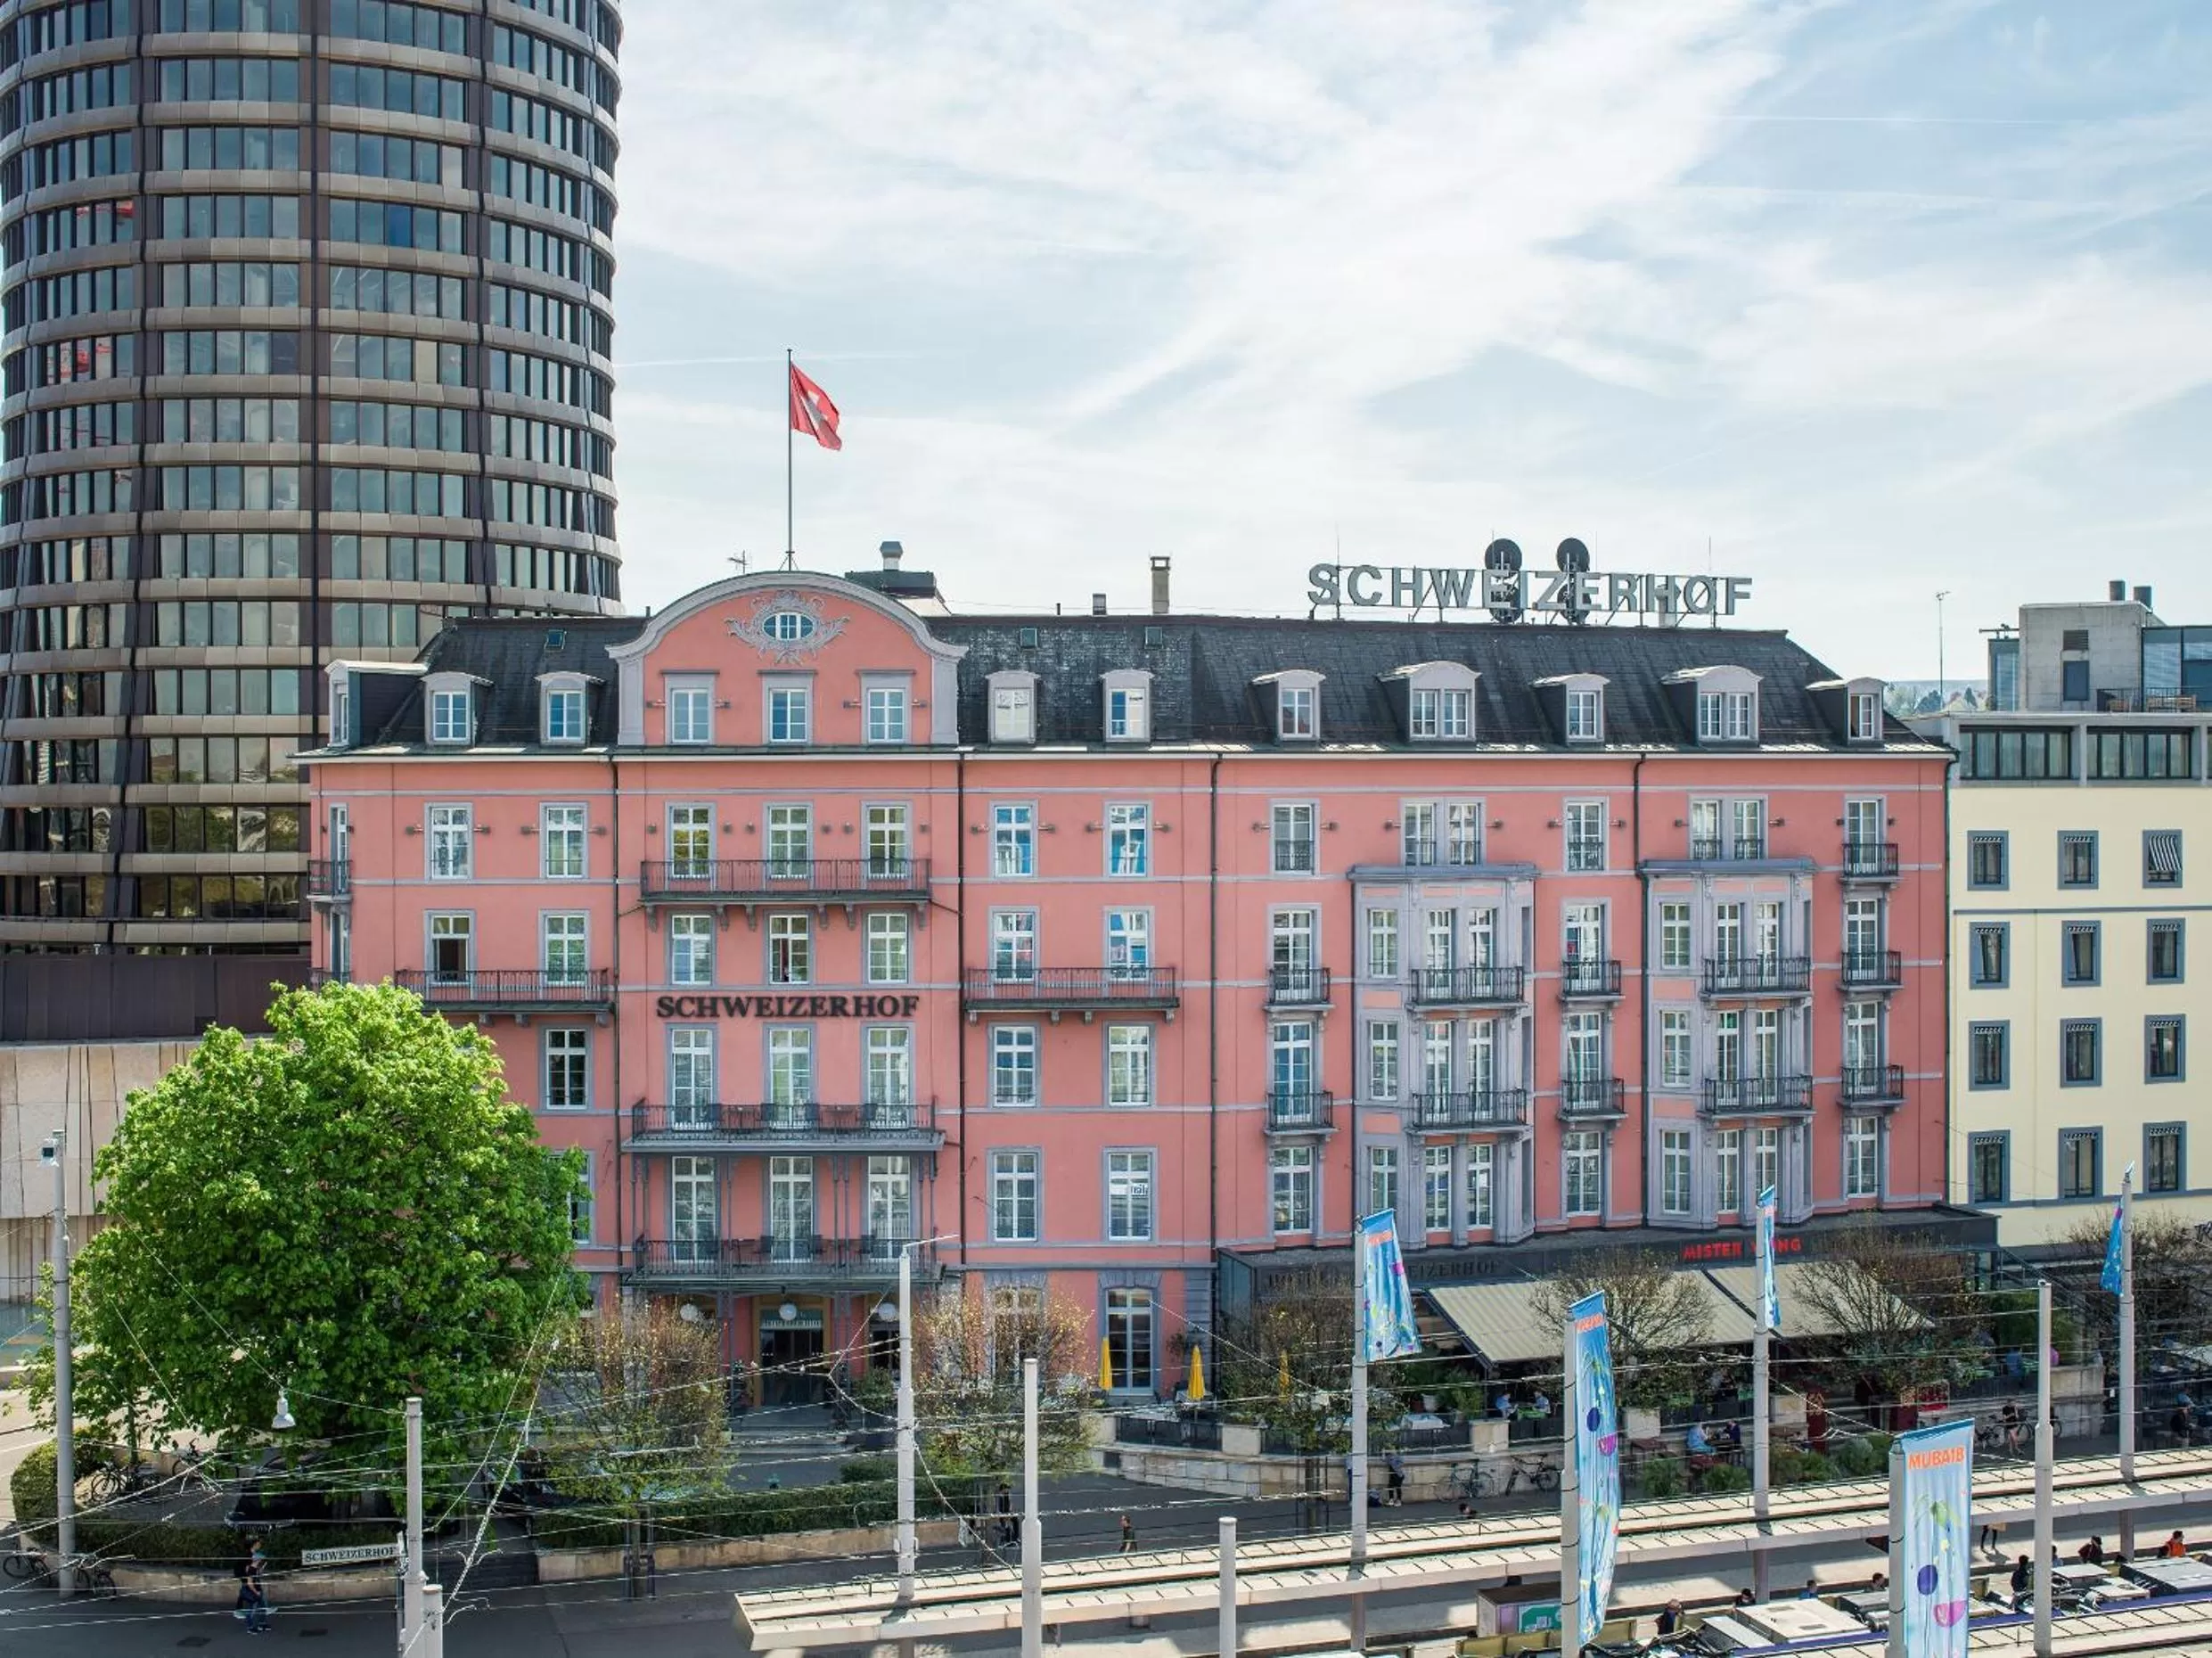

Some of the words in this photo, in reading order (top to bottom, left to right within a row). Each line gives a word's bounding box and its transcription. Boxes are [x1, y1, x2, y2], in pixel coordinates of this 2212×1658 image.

[1307, 563, 1753, 615] SCHWEIZERHOF
[656, 995, 920, 1018] SCHWEIZERHOF
[1683, 1241, 1743, 1260] MISTER
[305, 1547, 397, 1563] SCHWEIZERHOF
